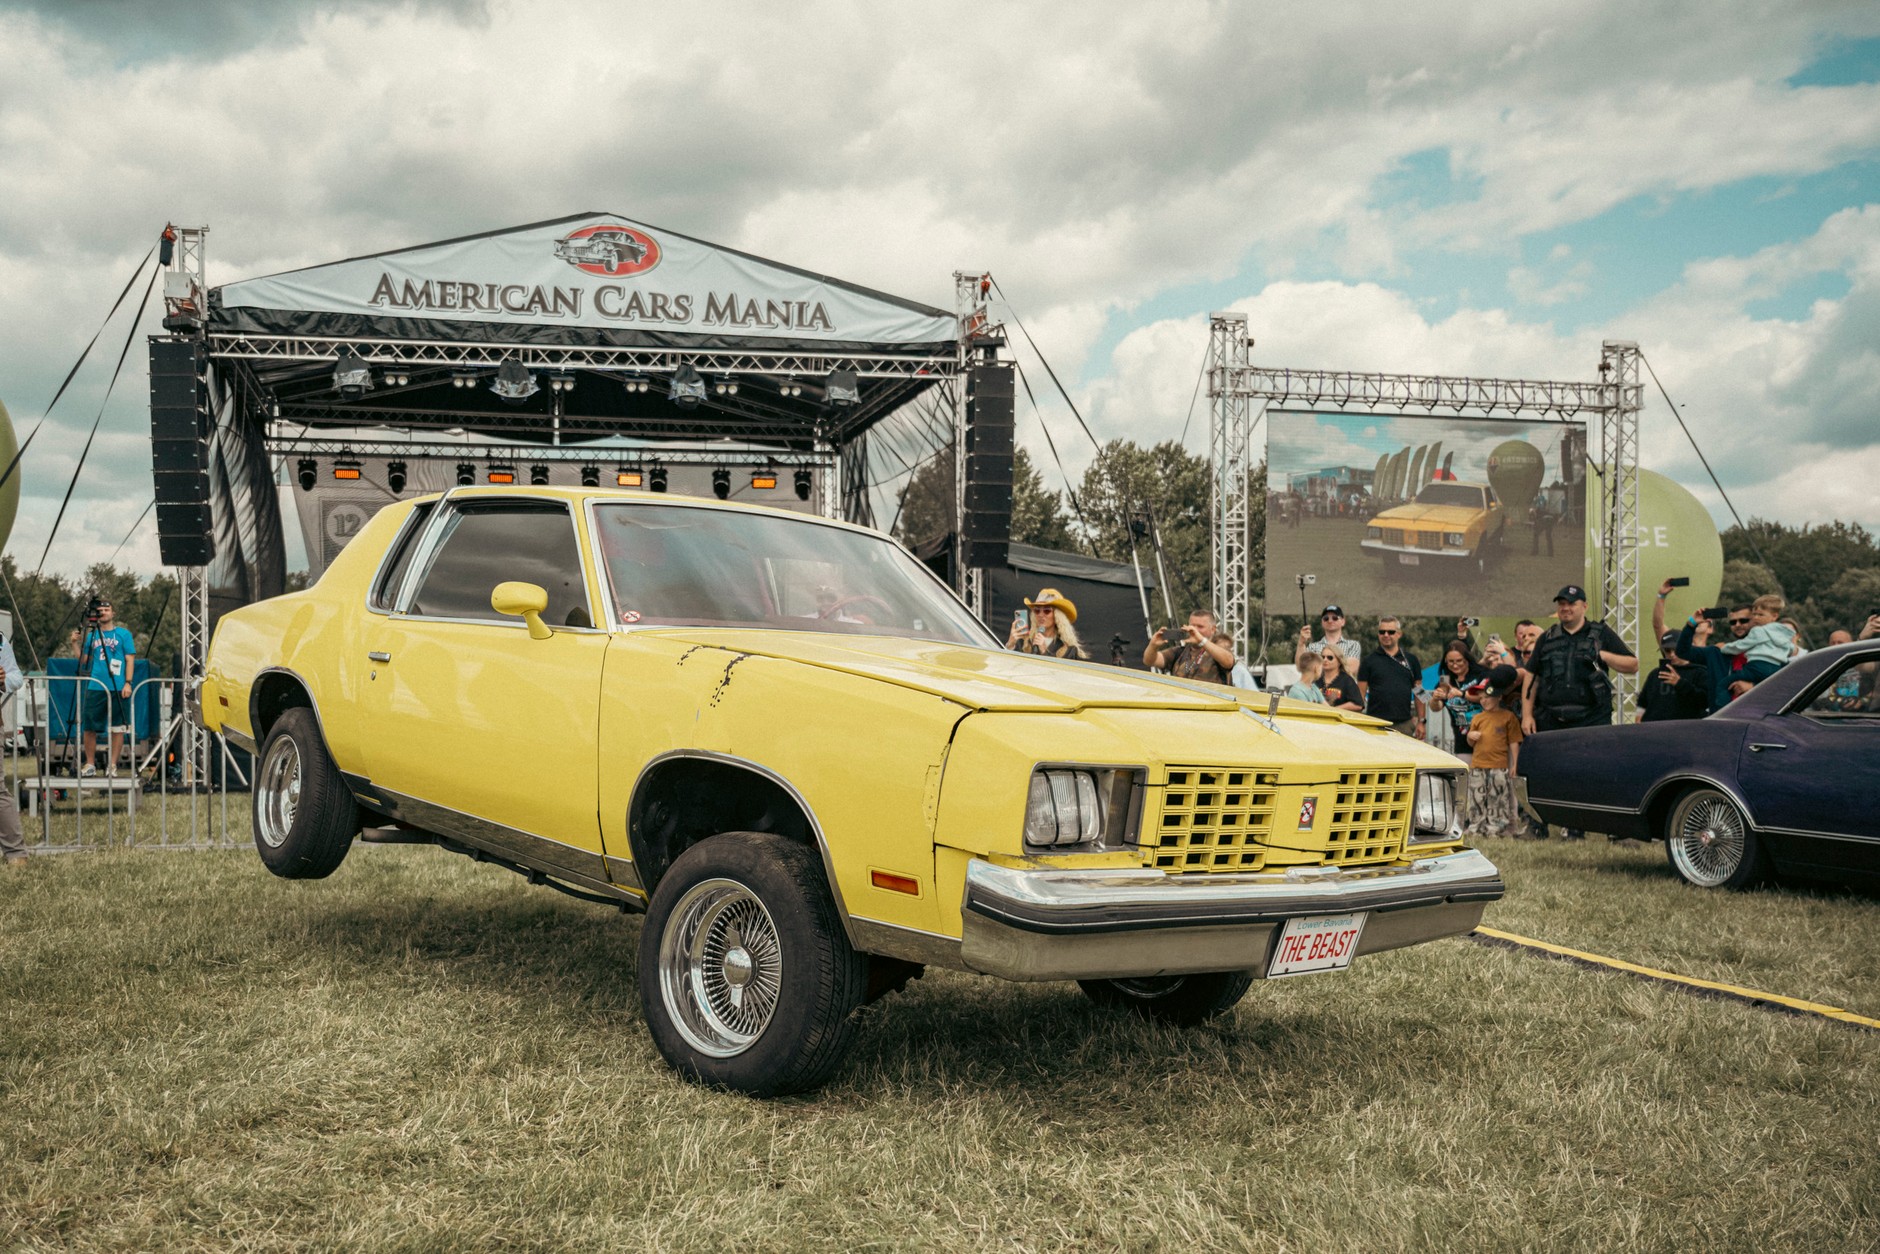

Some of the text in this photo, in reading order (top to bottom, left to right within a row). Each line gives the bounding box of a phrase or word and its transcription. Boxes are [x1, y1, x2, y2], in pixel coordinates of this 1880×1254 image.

[368, 272, 835, 333] AMERICAN CARS MANIA
[333, 513, 361, 537] 12
[1297, 918, 1353, 930] Lower Bavaria
[1279, 929, 1357, 963] THE BEAST
